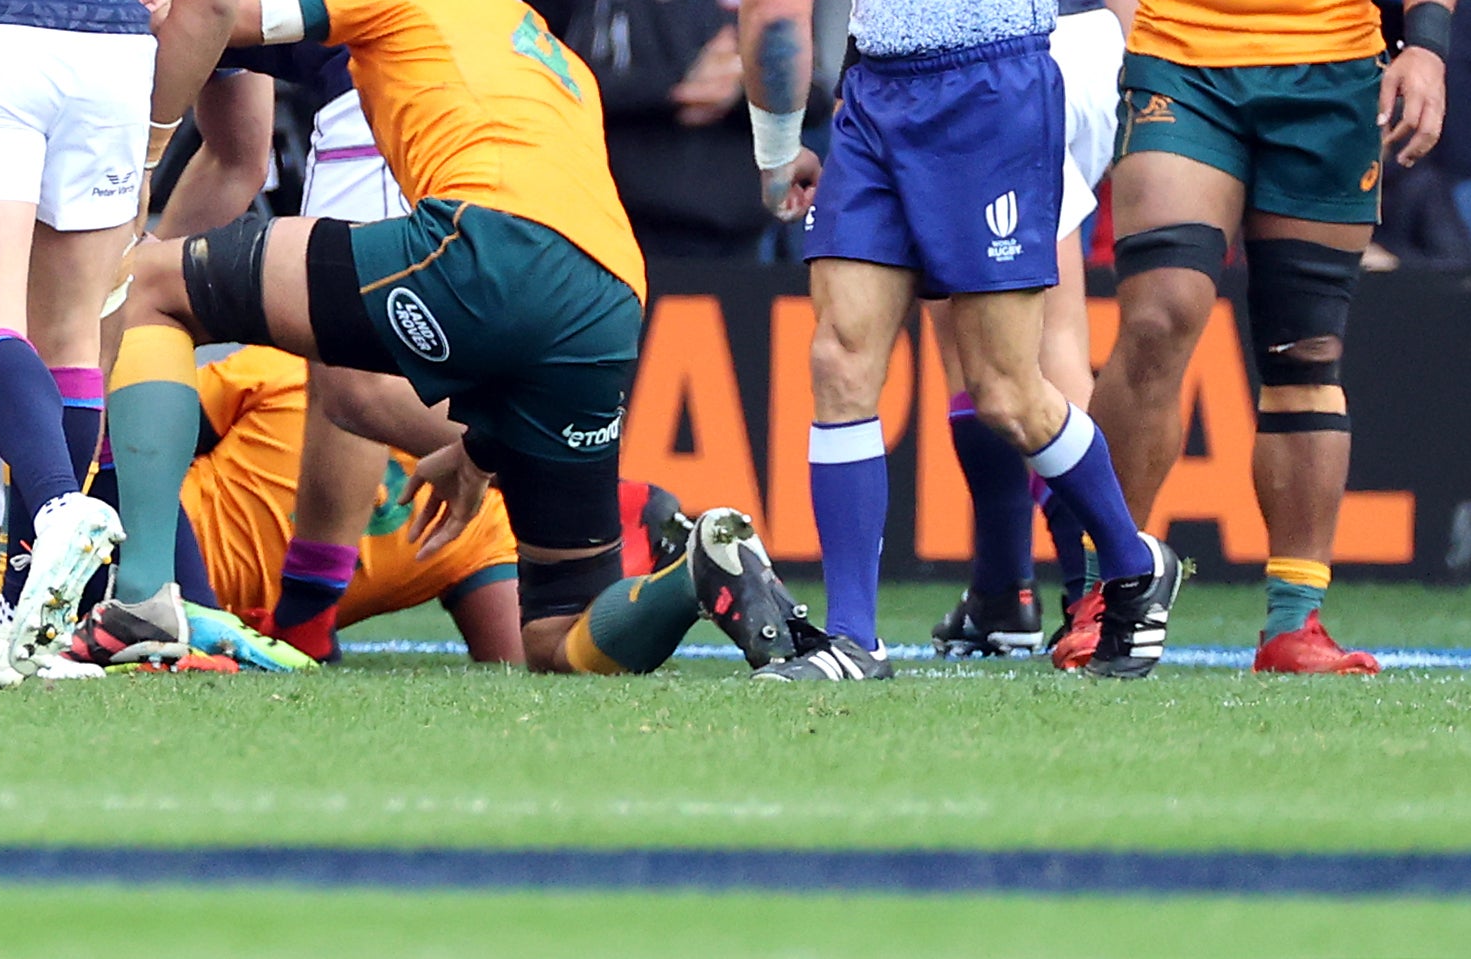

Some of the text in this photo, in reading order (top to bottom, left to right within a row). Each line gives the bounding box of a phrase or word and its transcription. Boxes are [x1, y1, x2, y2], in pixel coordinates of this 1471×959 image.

[988, 245, 1022, 257] RUGBY
[396, 309, 432, 351] ROVER
[405, 303, 435, 339] LAND
